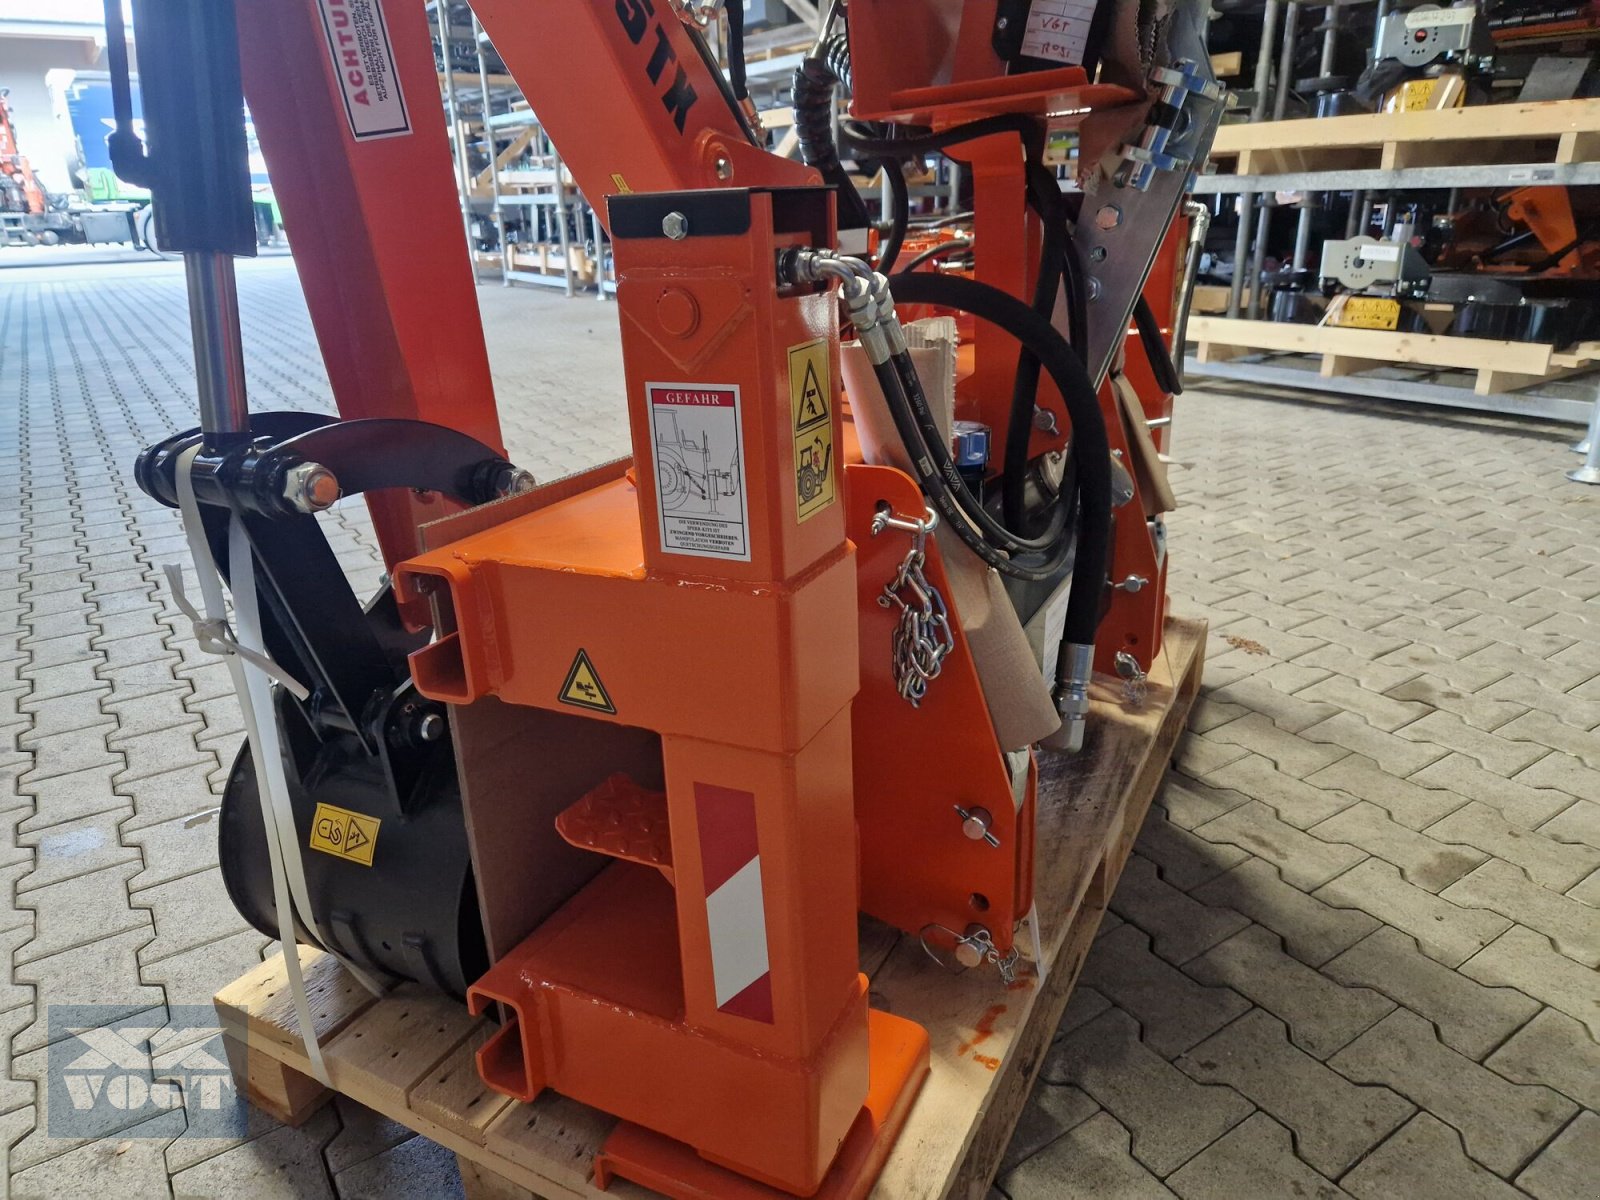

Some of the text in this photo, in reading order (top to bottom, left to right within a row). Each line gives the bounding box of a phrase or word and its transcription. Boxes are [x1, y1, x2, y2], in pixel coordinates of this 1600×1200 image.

[360, 0, 368, 21] FIRM
[365, 0, 374, 27] UNFÄL
[352, 10, 366, 58] VERBOTEN,
[361, 25, 383, 101] BETRIEBSBEREICH
[363, 60, 371, 73] IST
[377, 49, 386, 72] NICHT
[367, 75, 374, 86] ES
[666, 392, 720, 405] GEFAHR
[687, 520, 718, 528] VERWENDUNG
